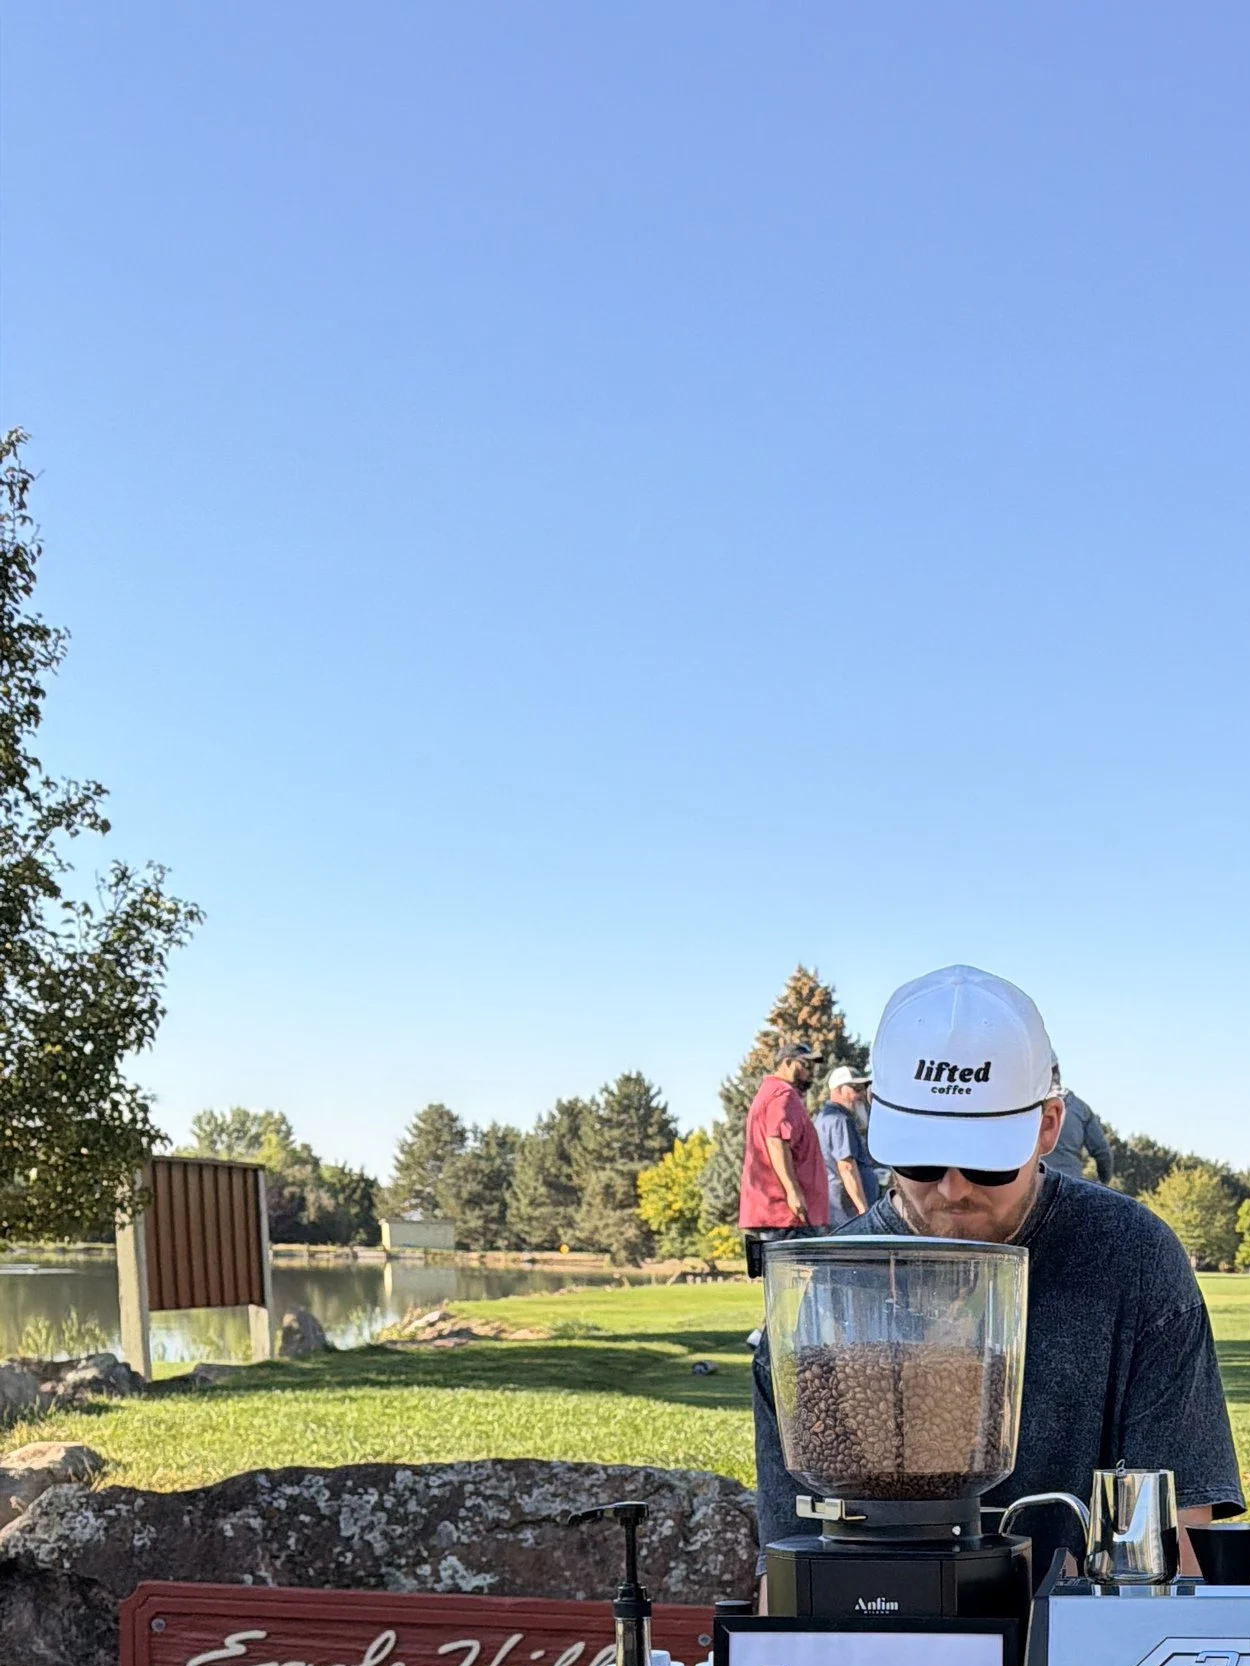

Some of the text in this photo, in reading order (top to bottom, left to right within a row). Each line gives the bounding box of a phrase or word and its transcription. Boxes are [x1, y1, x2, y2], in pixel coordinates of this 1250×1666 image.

[914, 1060, 992, 1083] lifted
[931, 1085, 972, 1095] coffee
[854, 1597, 899, 1610] Anfim
